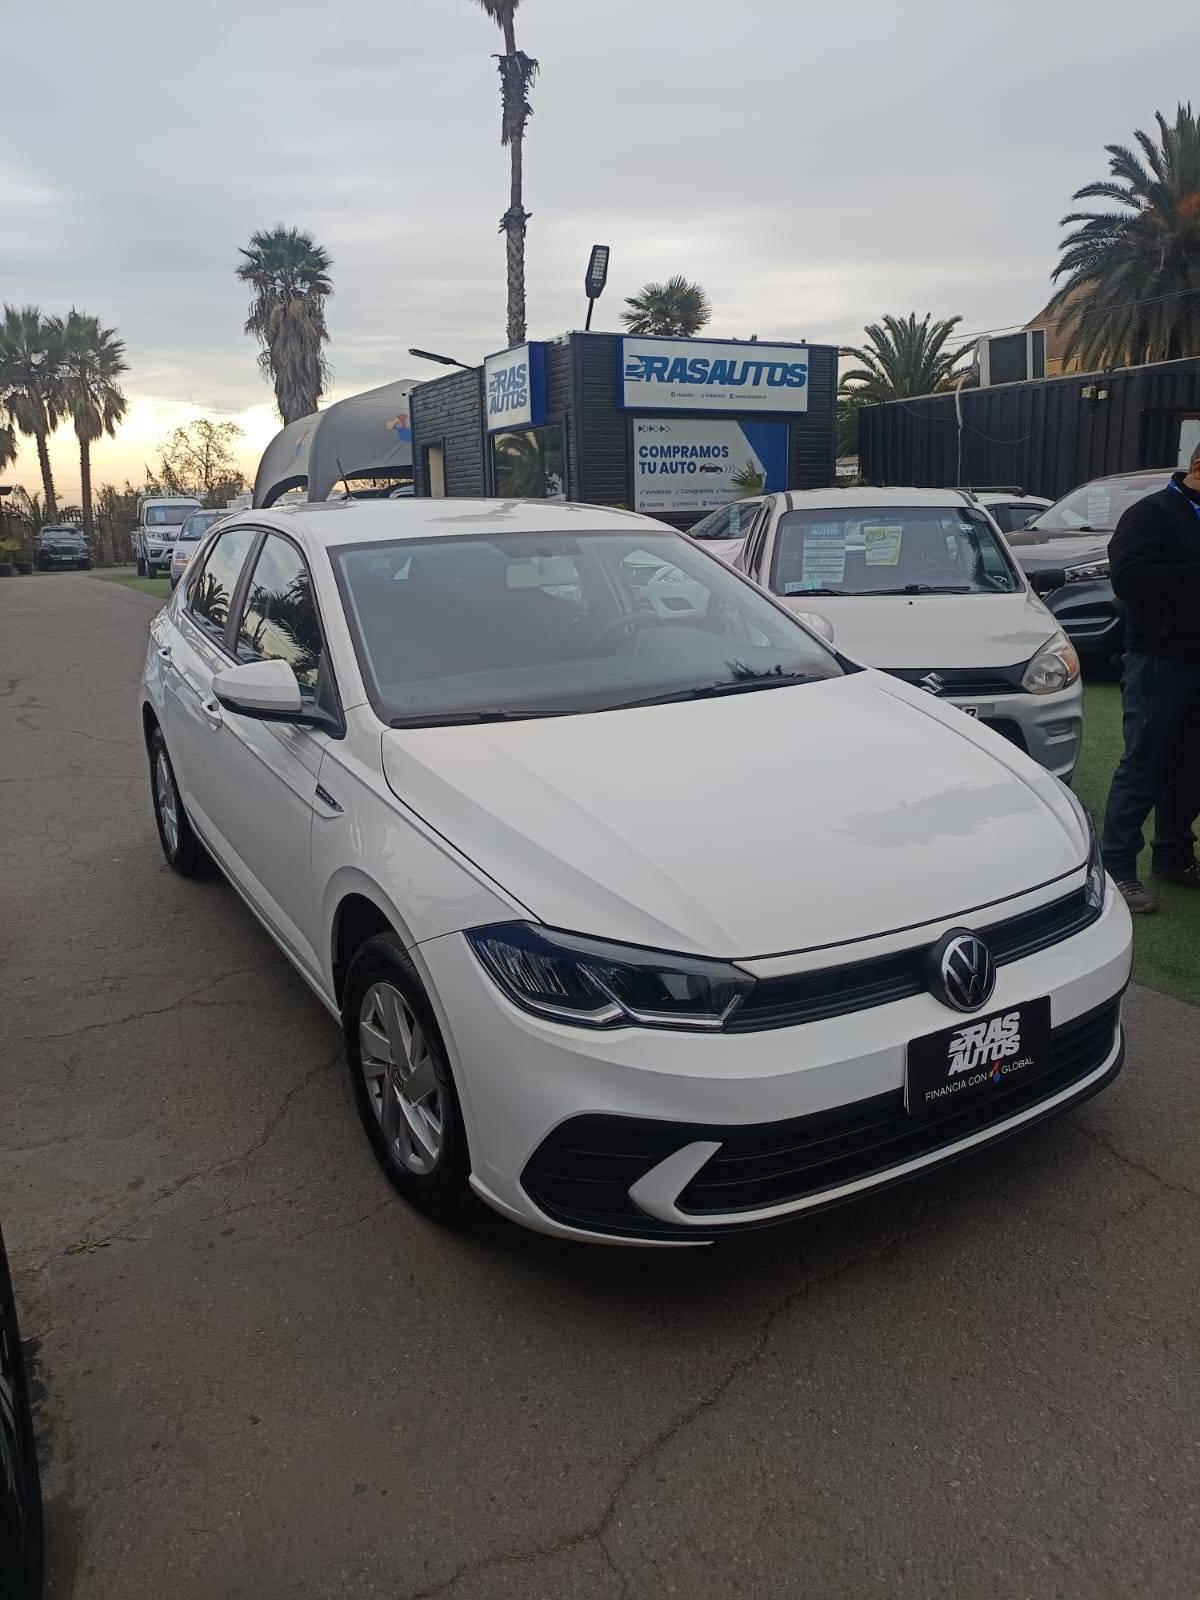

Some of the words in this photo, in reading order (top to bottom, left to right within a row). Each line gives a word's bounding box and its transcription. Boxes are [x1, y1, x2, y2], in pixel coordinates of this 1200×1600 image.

[490, 363, 527, 394] RAS
[635, 355, 808, 388] RASAUTOS
[489, 388, 527, 415] AUTOS
[639, 445, 729, 458] COMPRAMOS
[639, 461, 657, 474] TU
[659, 461, 697, 474] AUTO
[953, 1012, 1020, 1049] RAS
[948, 1035, 1020, 1076] AUTOS
[925, 1080, 967, 1101] FINANCIA
[968, 1073, 987, 1087] CON
[1001, 1057, 1034, 1074] GLOBAL
